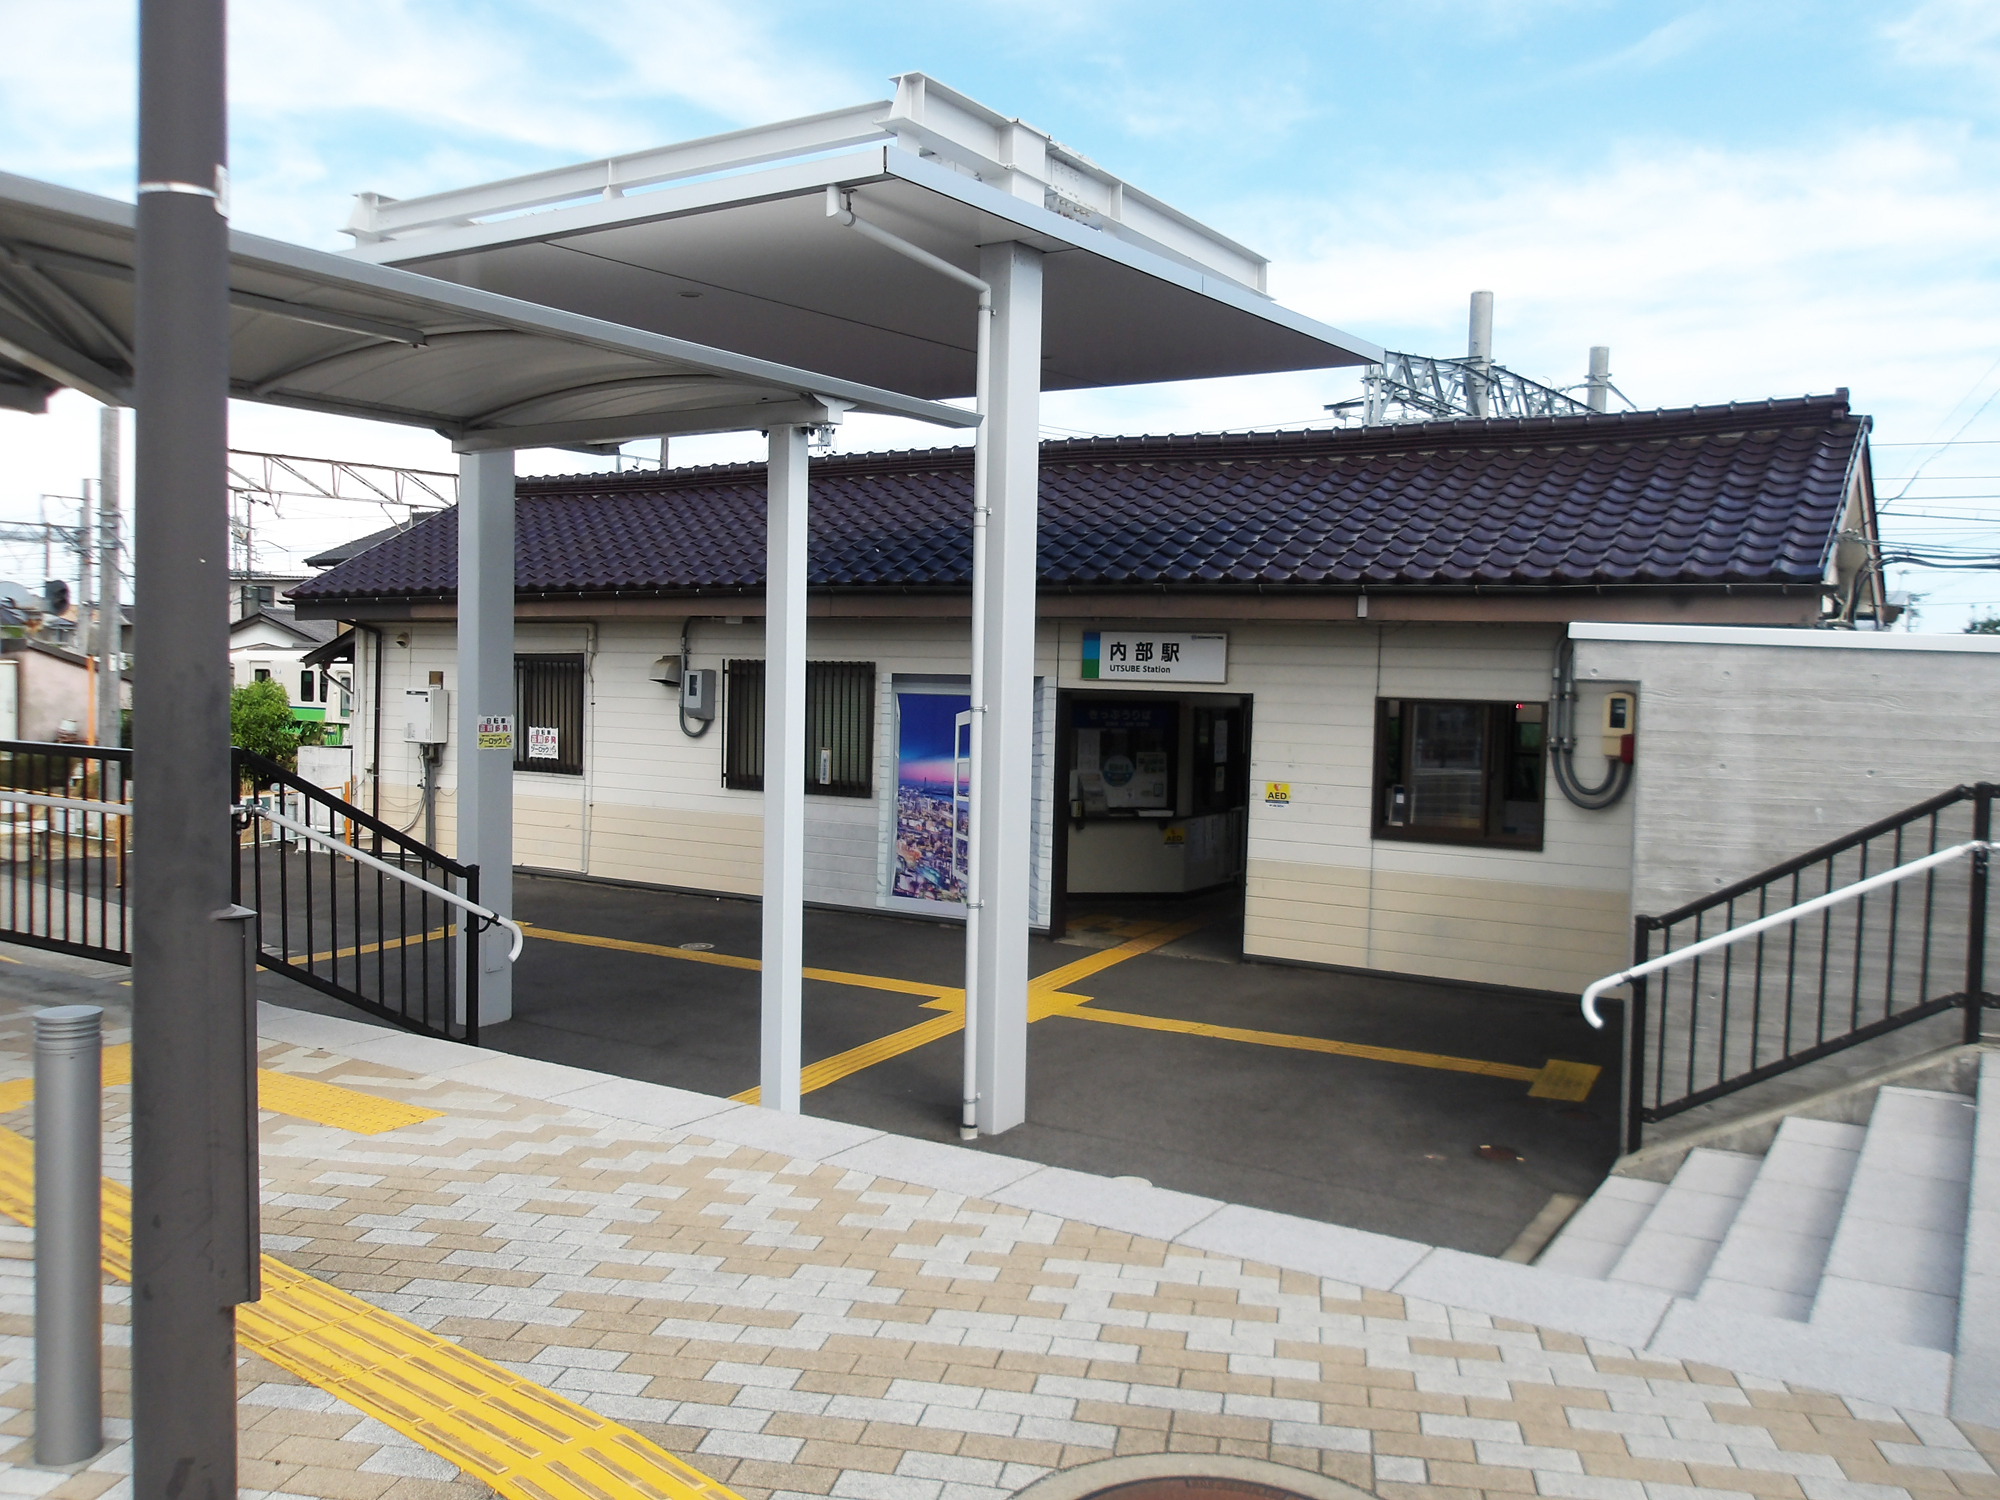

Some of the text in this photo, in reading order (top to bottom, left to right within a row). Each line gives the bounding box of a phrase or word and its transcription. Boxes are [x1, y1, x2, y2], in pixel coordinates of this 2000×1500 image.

[1109, 641, 1180, 662] 内部駅
[1109, 664, 1171, 674] UTSUBE Station
[1267, 792, 1287, 800] AED
